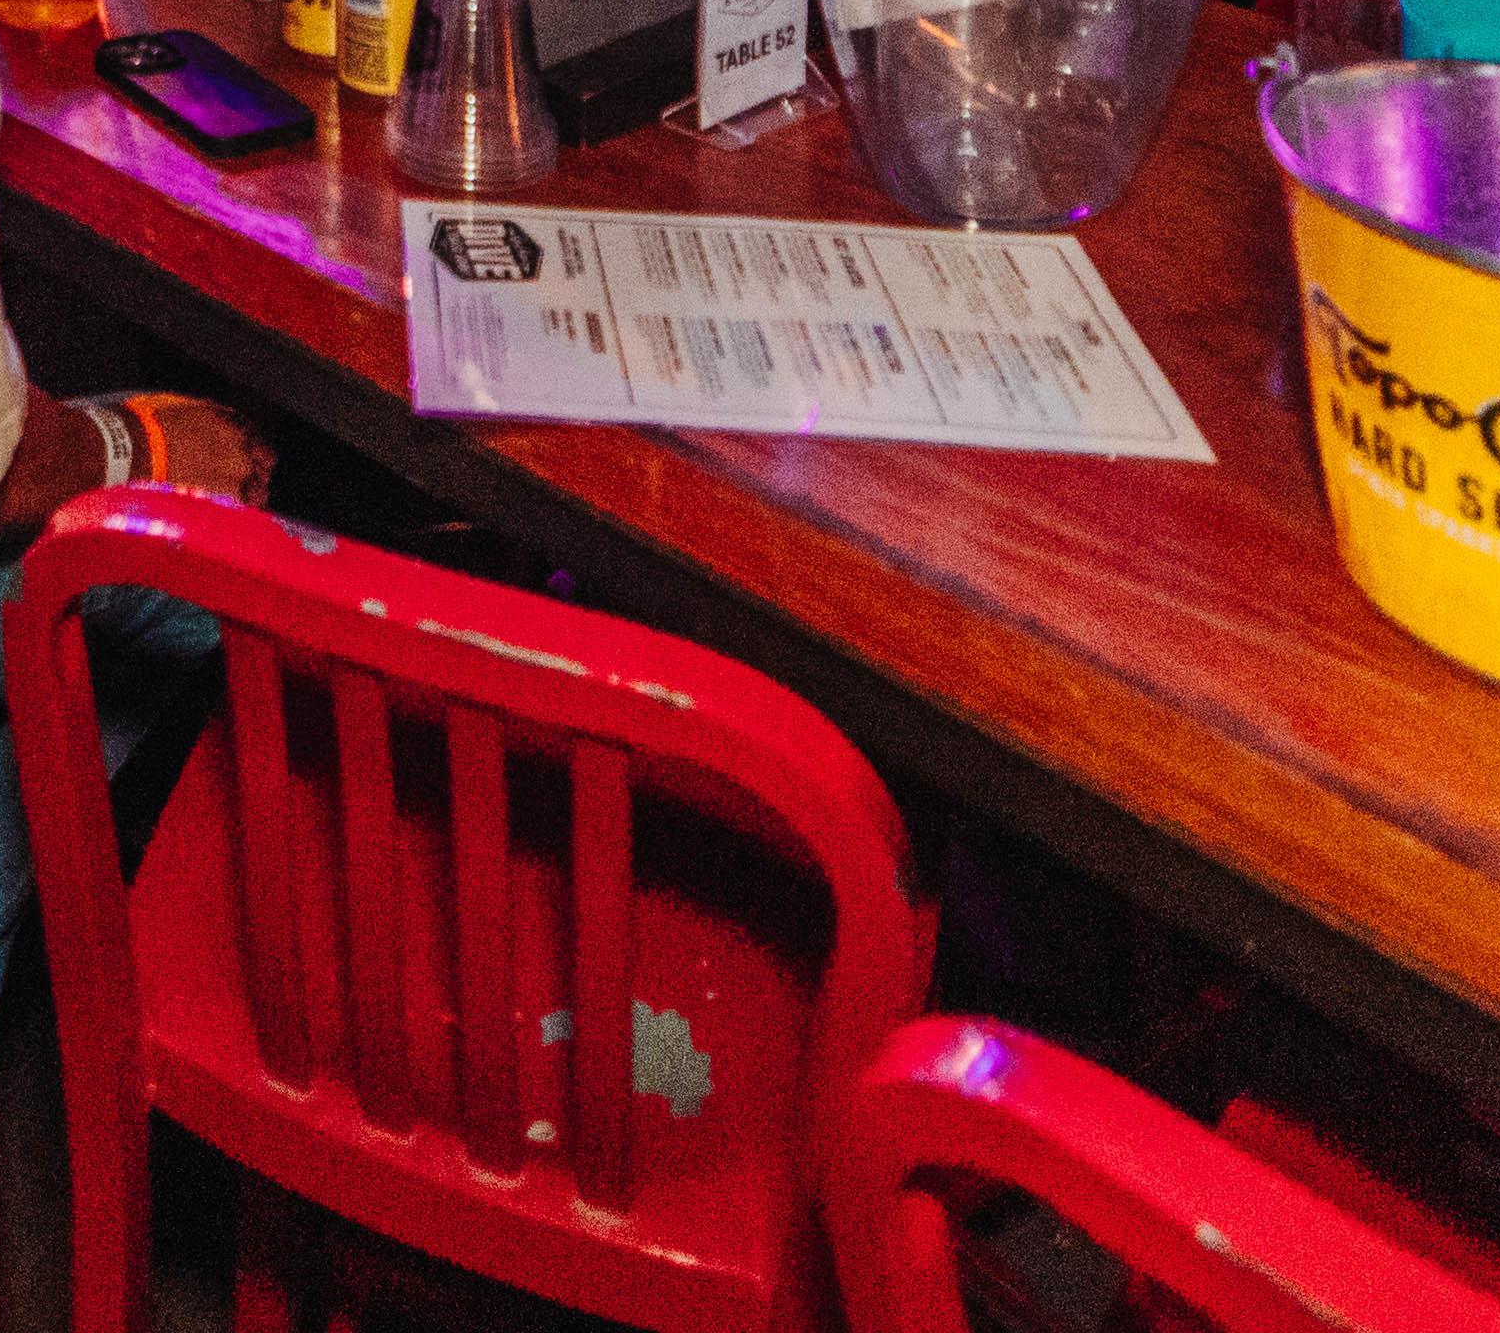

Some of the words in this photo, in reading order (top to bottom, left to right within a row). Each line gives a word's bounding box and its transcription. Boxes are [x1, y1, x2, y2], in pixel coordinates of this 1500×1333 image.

[716, 33, 772, 74] TABLE
[775, 24, 796, 52] 52
[1306, 281, 1470, 431] Topo
[1329, 388, 1427, 496] HARD
